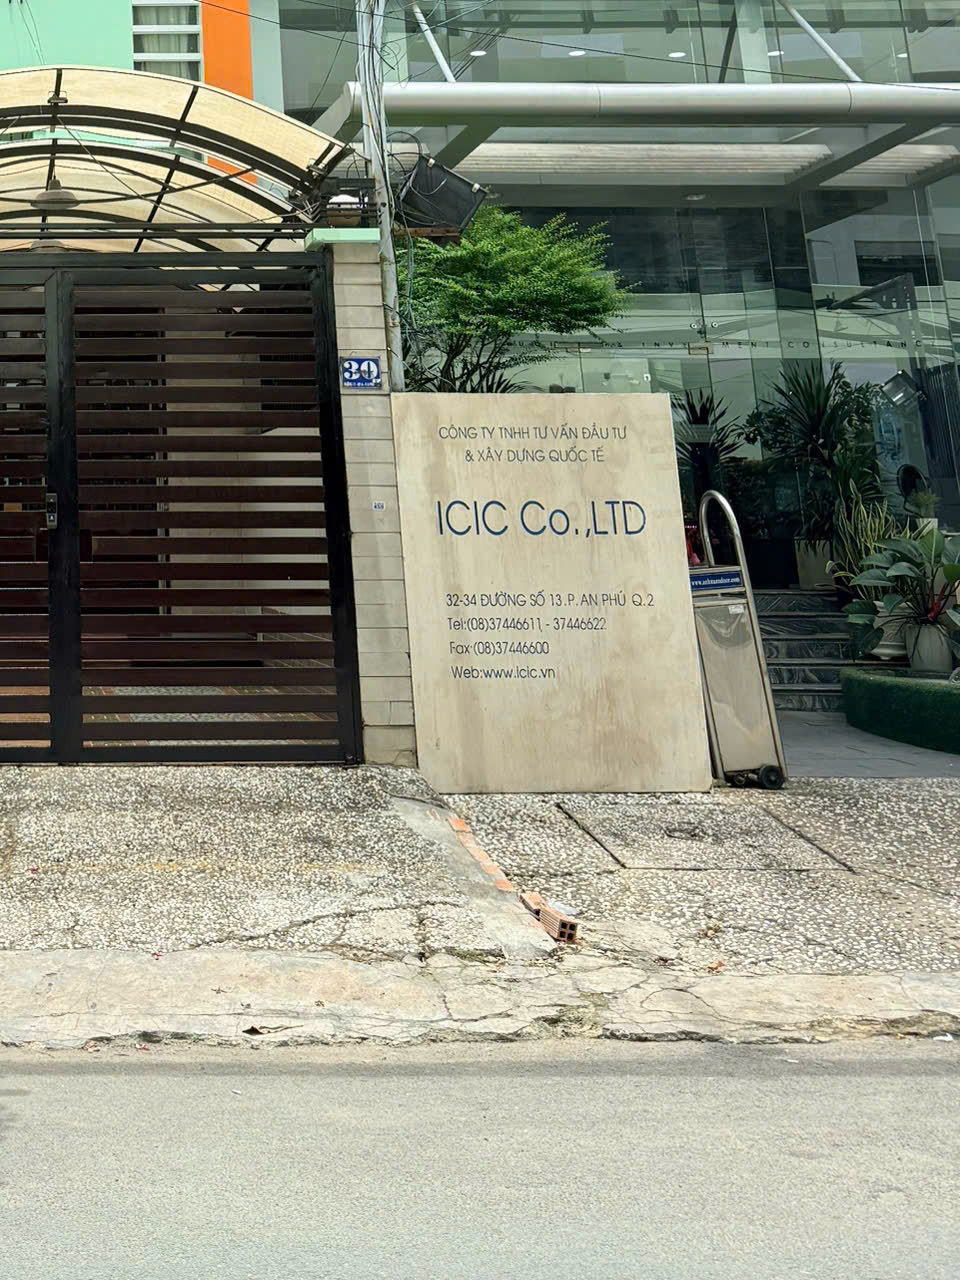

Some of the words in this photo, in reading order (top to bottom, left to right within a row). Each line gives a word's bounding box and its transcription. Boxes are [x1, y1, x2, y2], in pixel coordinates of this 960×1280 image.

[343, 360, 378, 380] 30
[438, 424, 478, 439] CÔNG
[482, 426, 495, 439] TY
[498, 426, 530, 439] TNHH
[533, 426, 549, 439] TƯ
[550, 422, 578, 439] VẤN
[612, 425, 627, 439] TƯ
[465, 450, 475, 462] &
[477, 447, 503, 462] XÂY
[507, 448, 545, 464] DỰNG
[549, 445, 588, 462] QUỐC
[591, 445, 605, 462] TẾ
[437, 500, 508, 536] ICIC
[446, 593, 477, 607] 32-34
[480, 590, 526, 607] ĐƯỜNG
[530, 589, 545, 607] SỐ
[602, 590, 626, 607] PHÚ
[553, 617, 607, 631] 37446622
